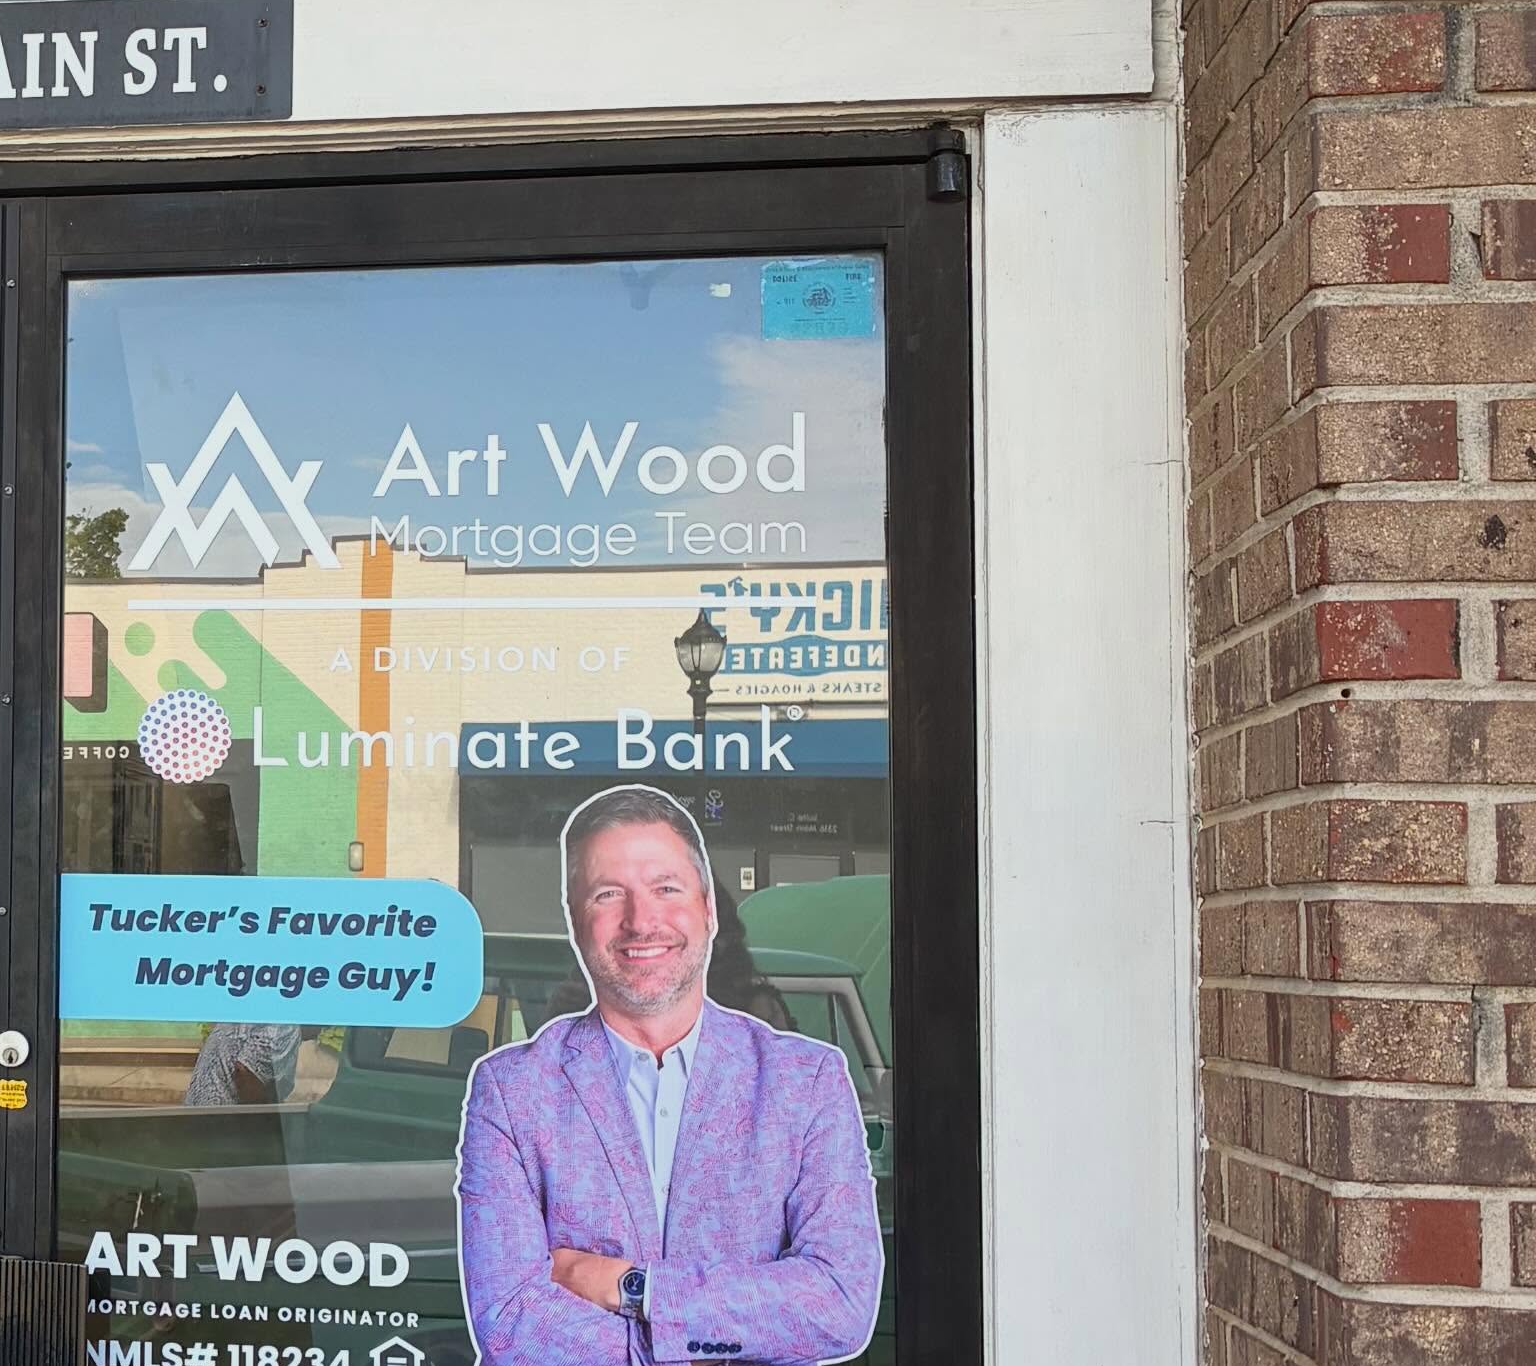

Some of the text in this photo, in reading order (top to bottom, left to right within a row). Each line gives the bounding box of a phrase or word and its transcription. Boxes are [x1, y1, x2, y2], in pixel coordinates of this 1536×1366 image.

[123, 24, 227, 94] ST.
[372, 411, 805, 498] Art Wood
[369, 511, 807, 566] Mortgage Team
[329, 646, 630, 673] A DIVISION OF
[252, 714, 579, 771] Luminate
[88, 903, 437, 939] Tucker's Favorite
[135, 956, 436, 1001] Mortgage Guy!
[84, 1232, 410, 1287] ART WOOD
[211, 1304, 268, 1321] LOAN
[277, 1307, 419, 1328] ORIGINATOR
